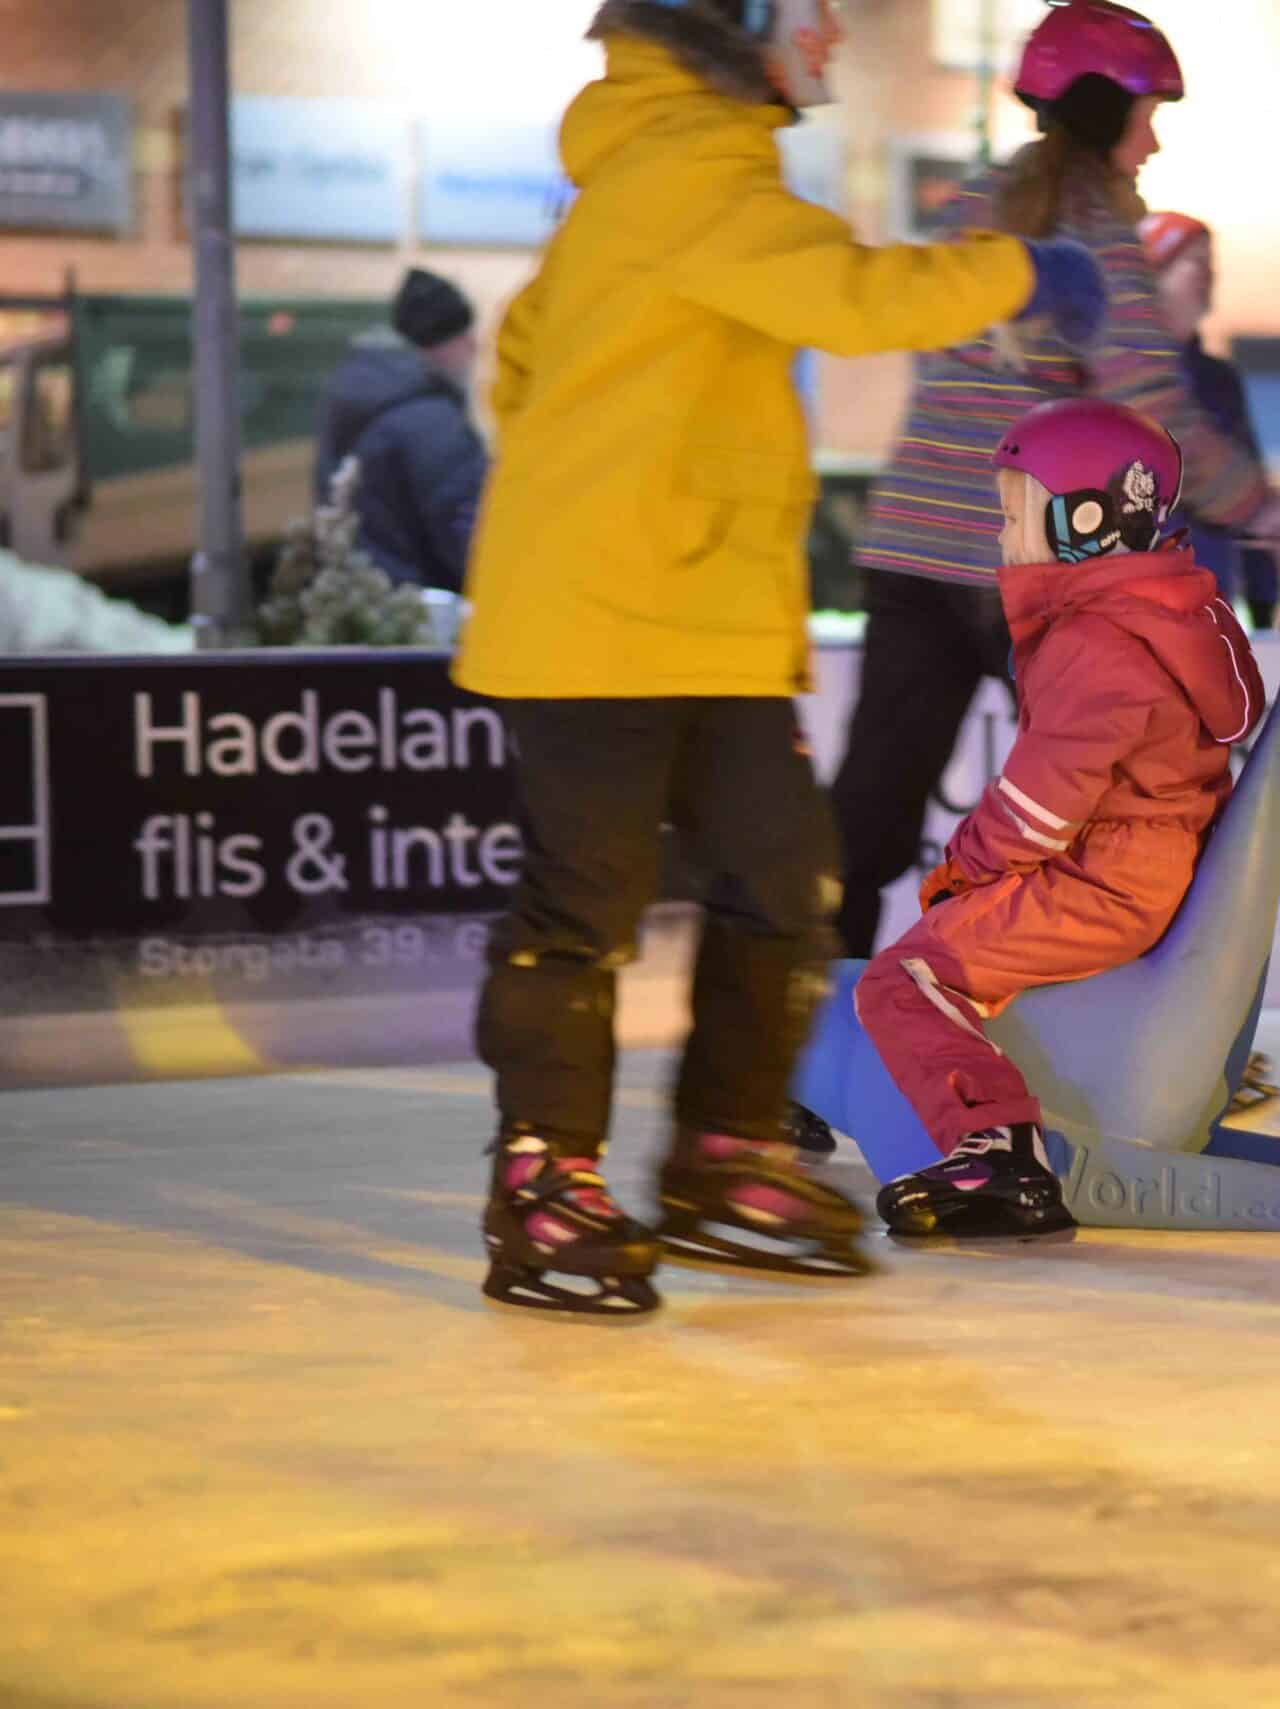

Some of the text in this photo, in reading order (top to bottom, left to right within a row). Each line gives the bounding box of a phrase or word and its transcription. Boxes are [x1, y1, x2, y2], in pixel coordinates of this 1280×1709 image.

[132, 686, 520, 778] Hadelan
[133, 804, 524, 900] flis & inte
